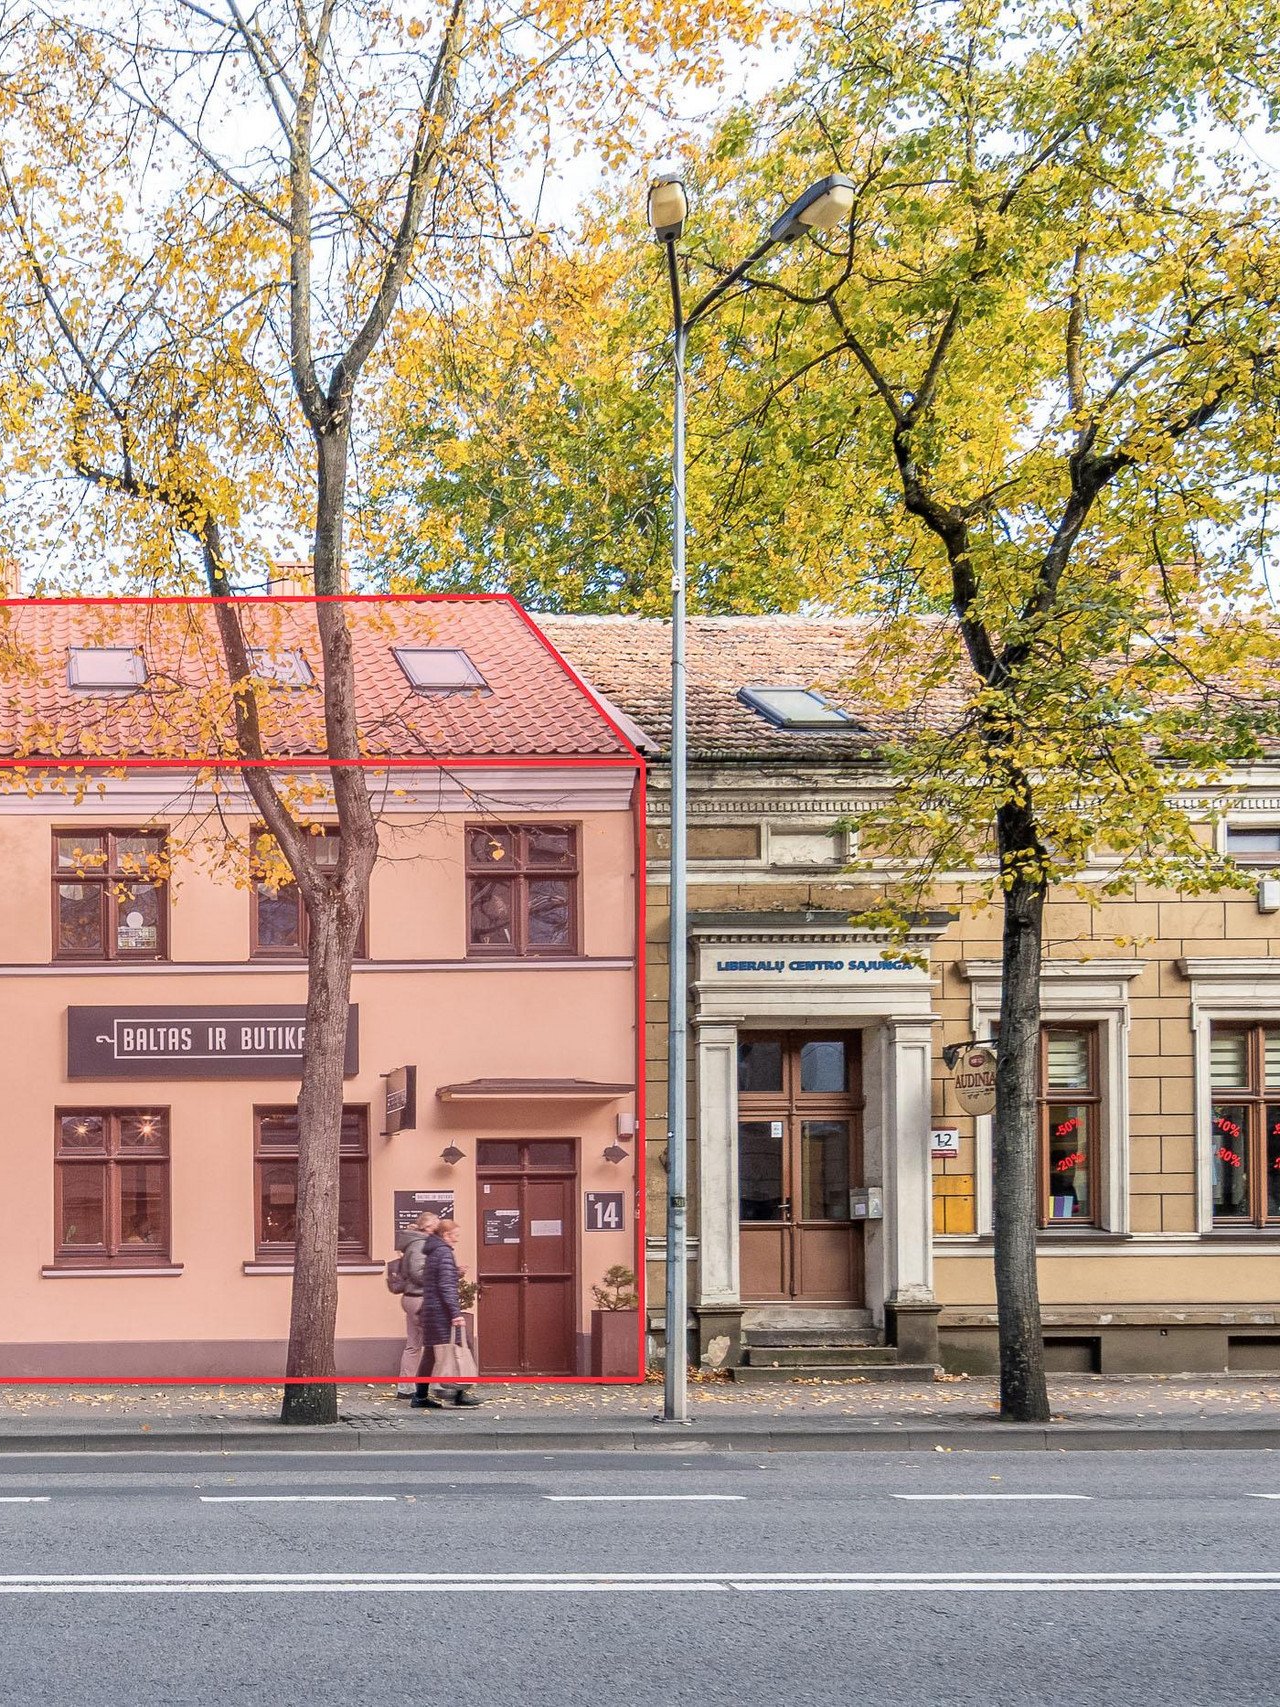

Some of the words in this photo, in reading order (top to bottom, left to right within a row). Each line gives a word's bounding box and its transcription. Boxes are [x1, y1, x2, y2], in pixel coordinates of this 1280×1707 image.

[717, 960, 785, 973] LIBERALŲ
[789, 960, 845, 971] CENTRO
[123, 1027, 192, 1051] BALTAS
[208, 1027, 227, 1051] IR
[241, 1026, 306, 1050] BUTIKA
[1055, 1117, 1084, 1136] -50%
[1056, 1153, 1086, 1172] -20%
[594, 1202, 619, 1229] 14
